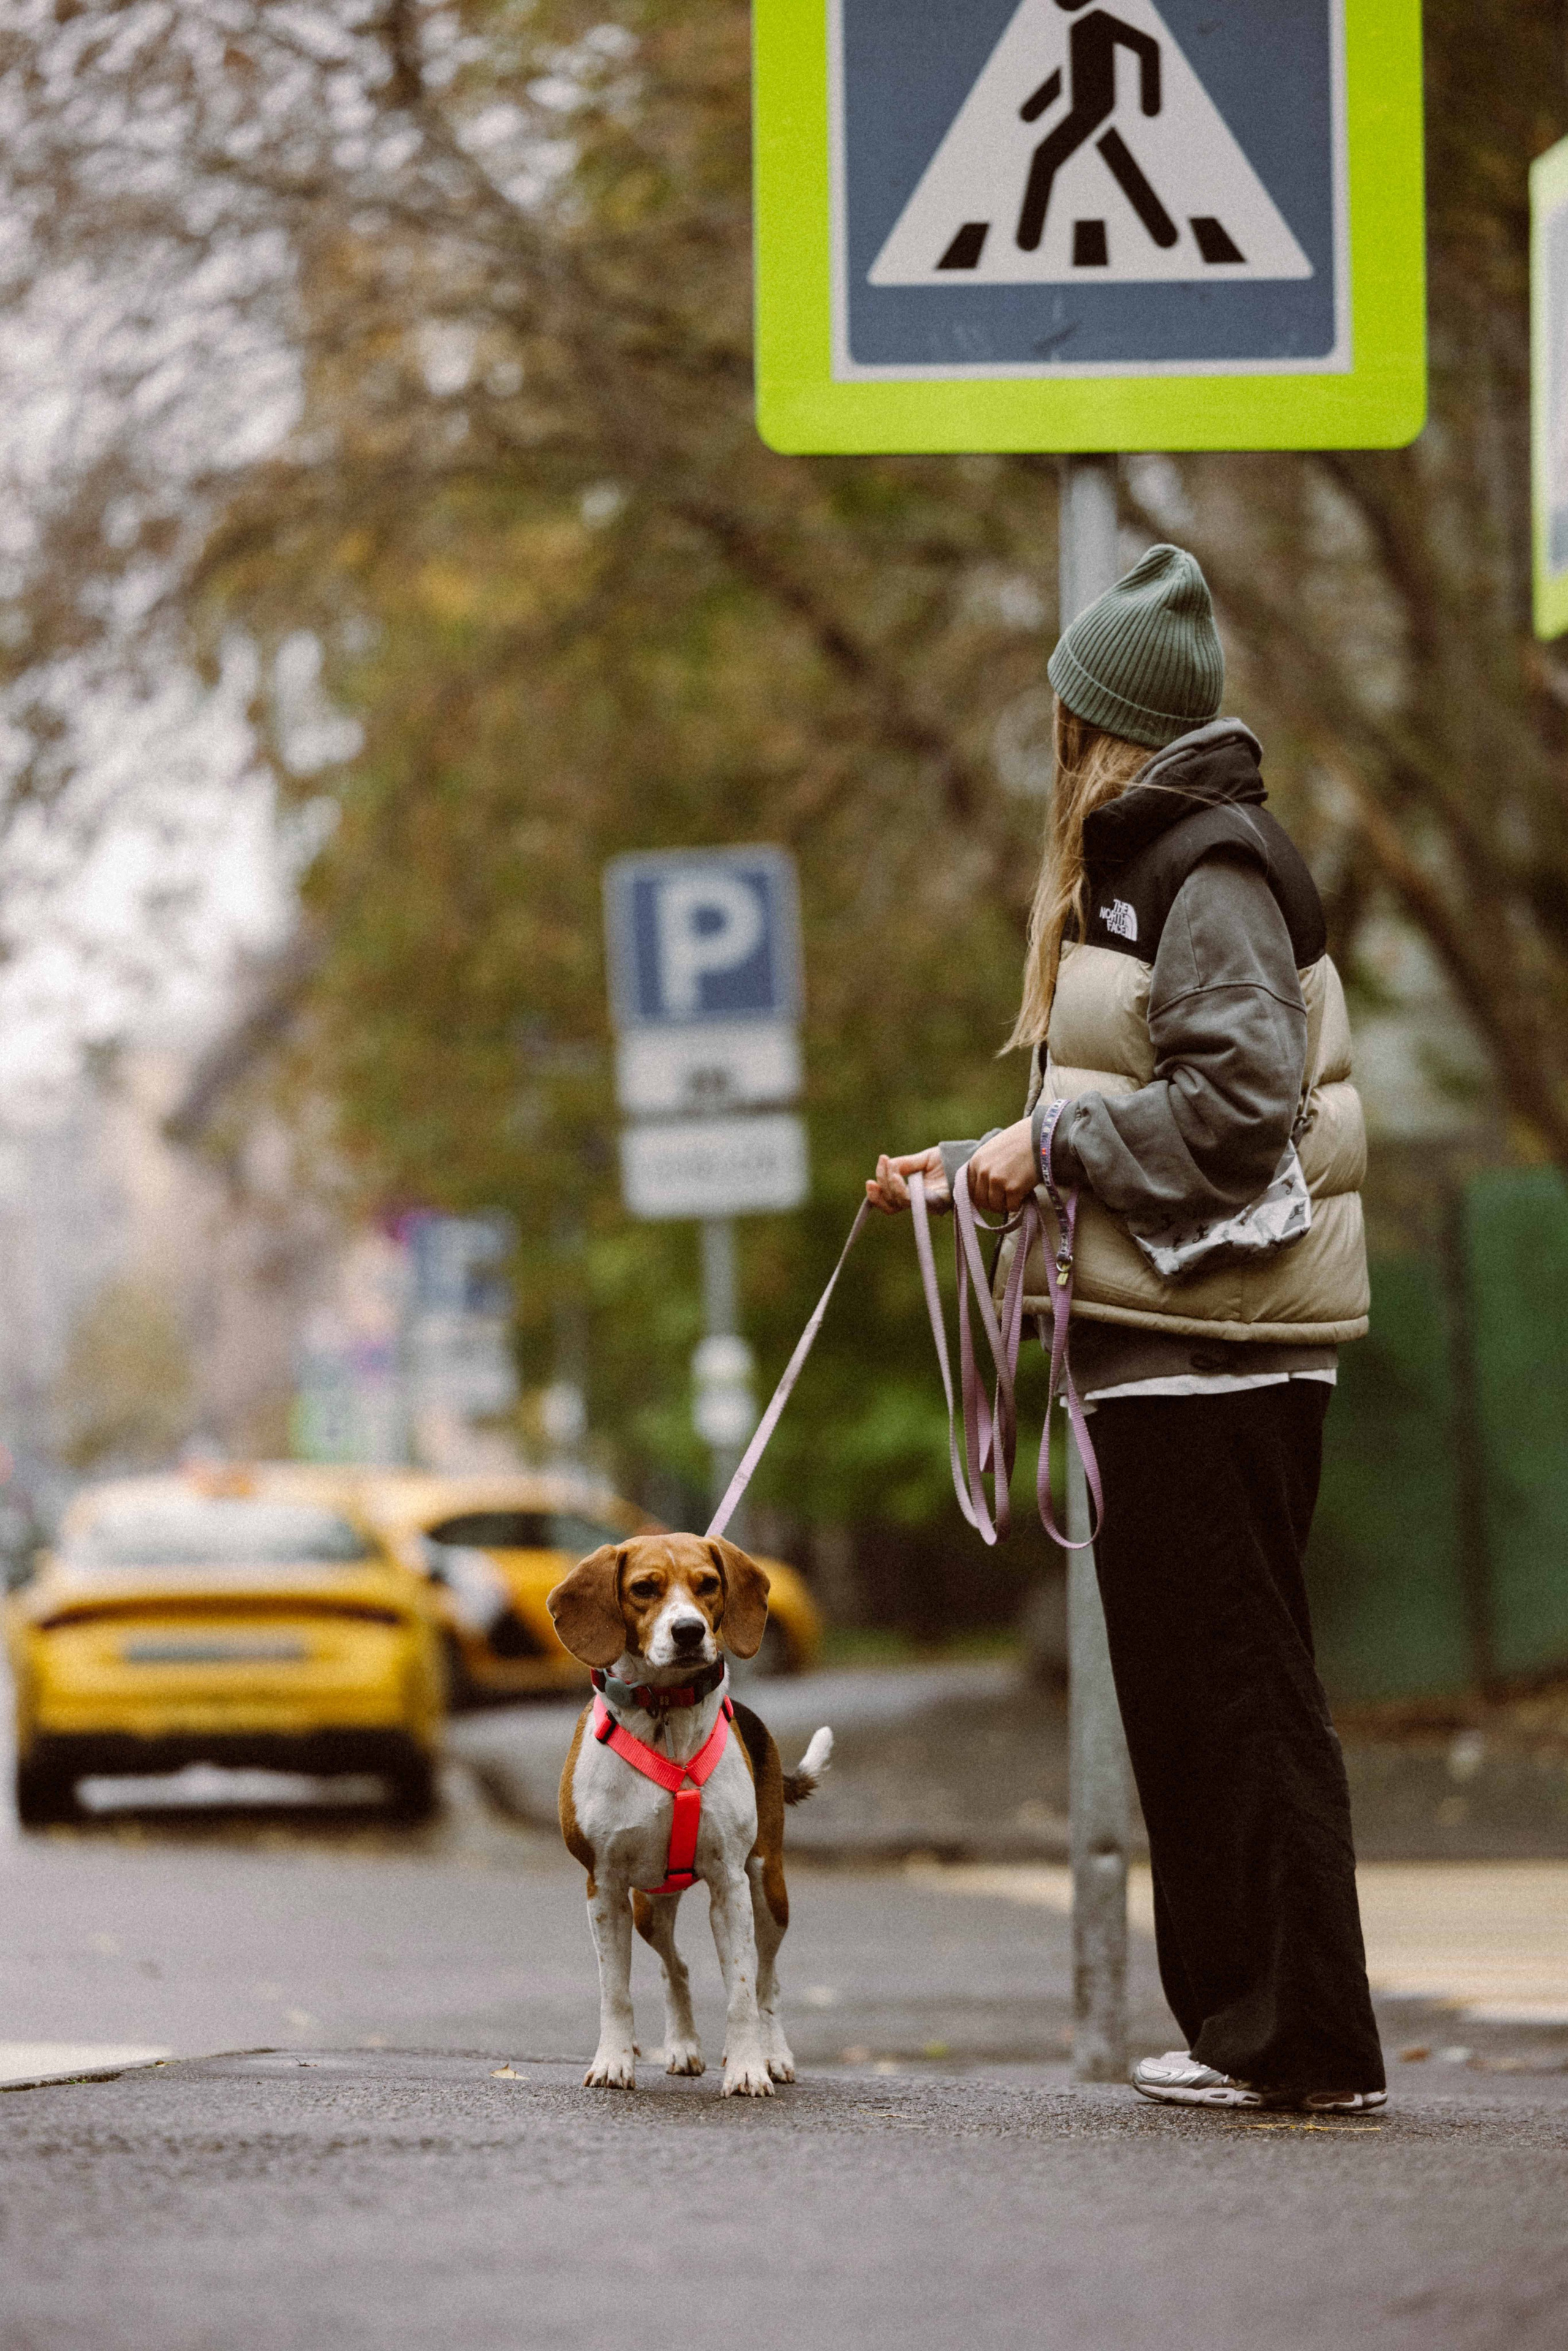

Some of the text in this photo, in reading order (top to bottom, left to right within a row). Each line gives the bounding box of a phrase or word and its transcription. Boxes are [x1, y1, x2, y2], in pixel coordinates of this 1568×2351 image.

[1099, 906, 1126, 925] NORTH
[1114, 899, 1128, 915] THE
[1107, 919, 1126, 935] FACE
[659, 872, 763, 1016] P
